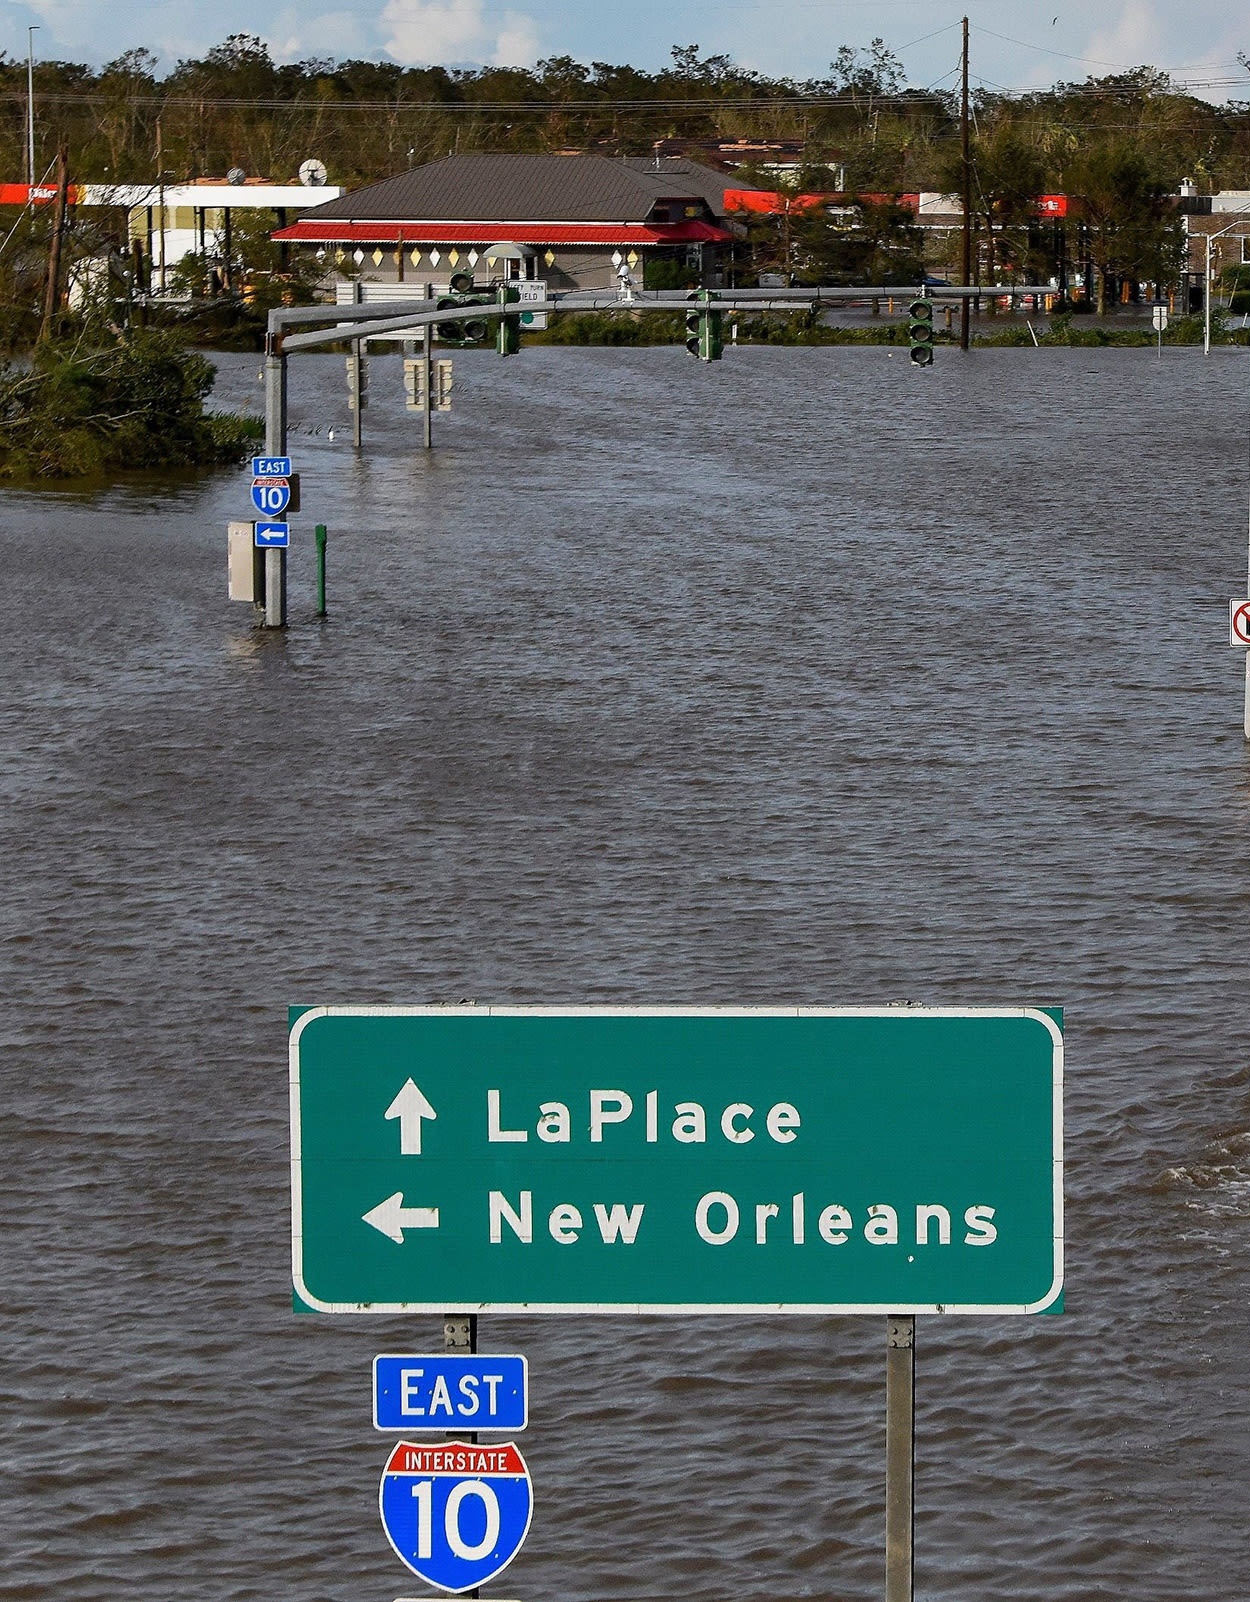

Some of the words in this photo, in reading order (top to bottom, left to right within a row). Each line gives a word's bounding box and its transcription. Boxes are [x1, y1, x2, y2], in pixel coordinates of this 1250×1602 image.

[259, 460, 285, 473] EAST
[260, 487, 283, 508] 10
[487, 1089, 802, 1144] LaPlace
[488, 1190, 645, 1245] New
[695, 1190, 999, 1247] Orleans
[400, 1368, 504, 1417] EAST
[405, 1451, 508, 1471] INTERSTATE
[411, 1479, 501, 1561] 10
